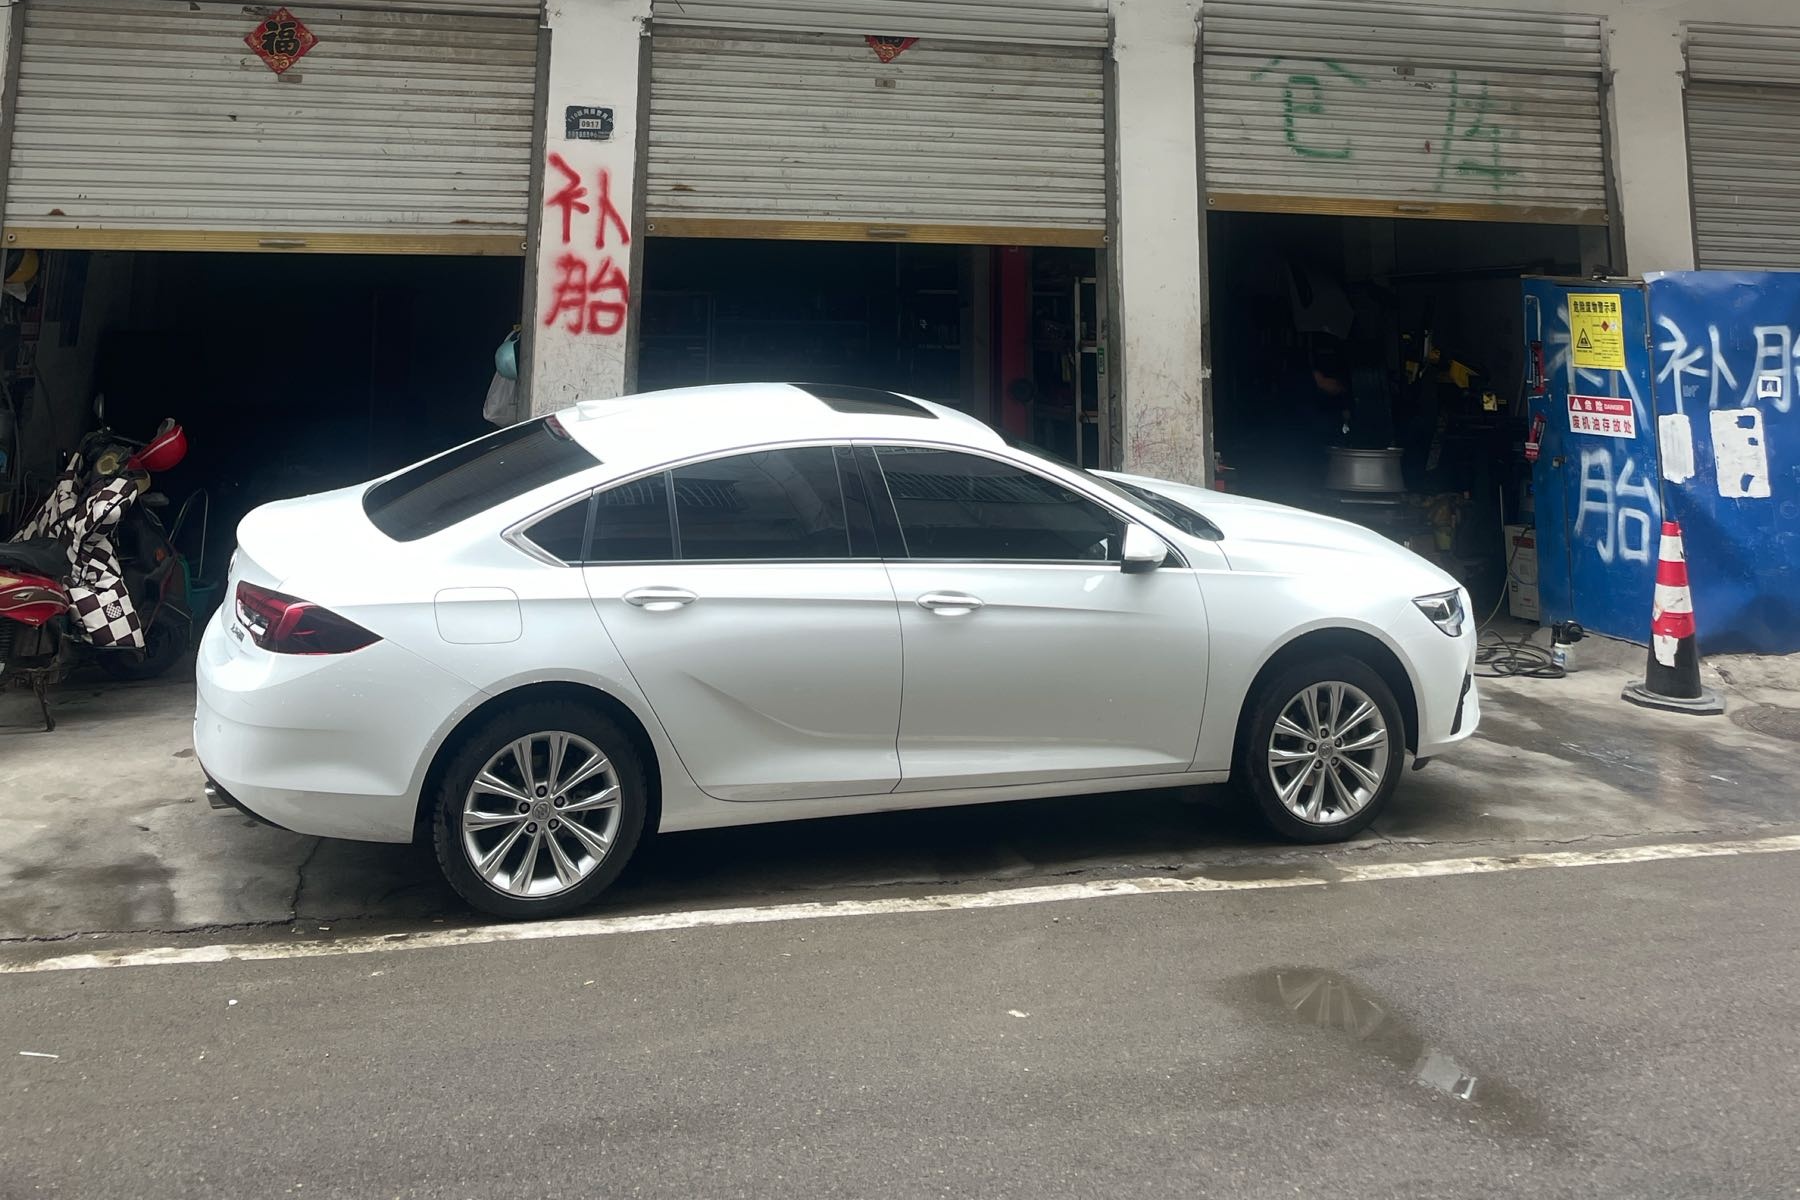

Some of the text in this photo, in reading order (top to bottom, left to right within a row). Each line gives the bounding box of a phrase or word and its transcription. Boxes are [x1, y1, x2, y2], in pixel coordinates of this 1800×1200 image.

[261, 20, 301, 57] 福
[544, 151, 631, 336] 补胎
[1584, 399, 1603, 412] 危险
[1572, 415, 1632, 434] 废机油存放处
